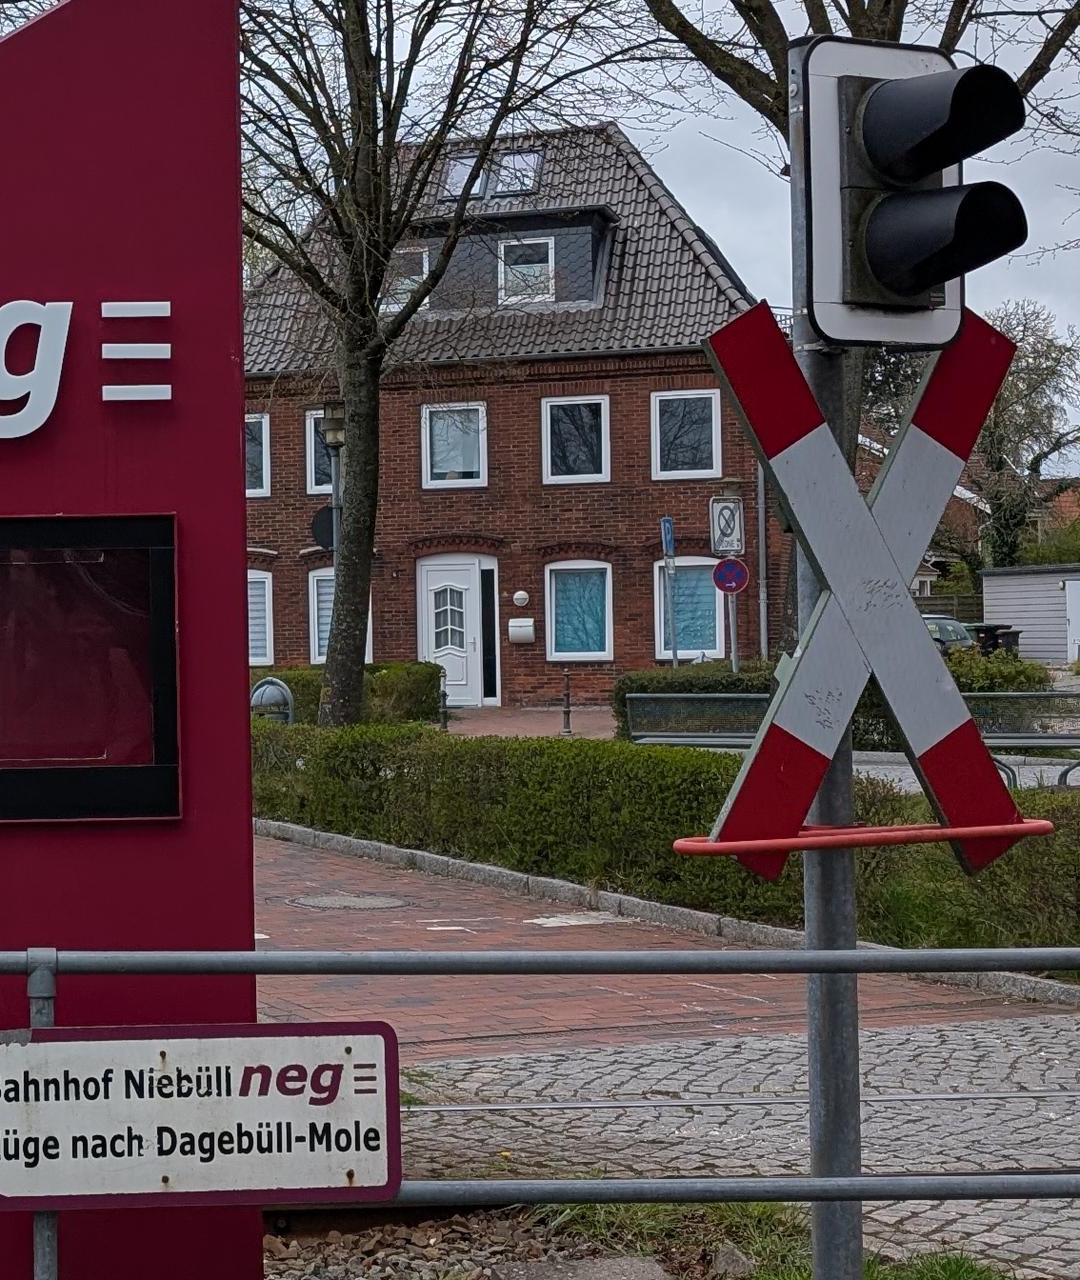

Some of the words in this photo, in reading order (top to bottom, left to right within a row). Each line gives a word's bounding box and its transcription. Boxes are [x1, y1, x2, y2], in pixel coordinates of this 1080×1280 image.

[124, 1066, 232, 1099] Niebüll
[238, 1063, 345, 1106] neg
[71, 1126, 145, 1158] nach
[156, 1120, 381, 1163] Dagebüll-Mole
